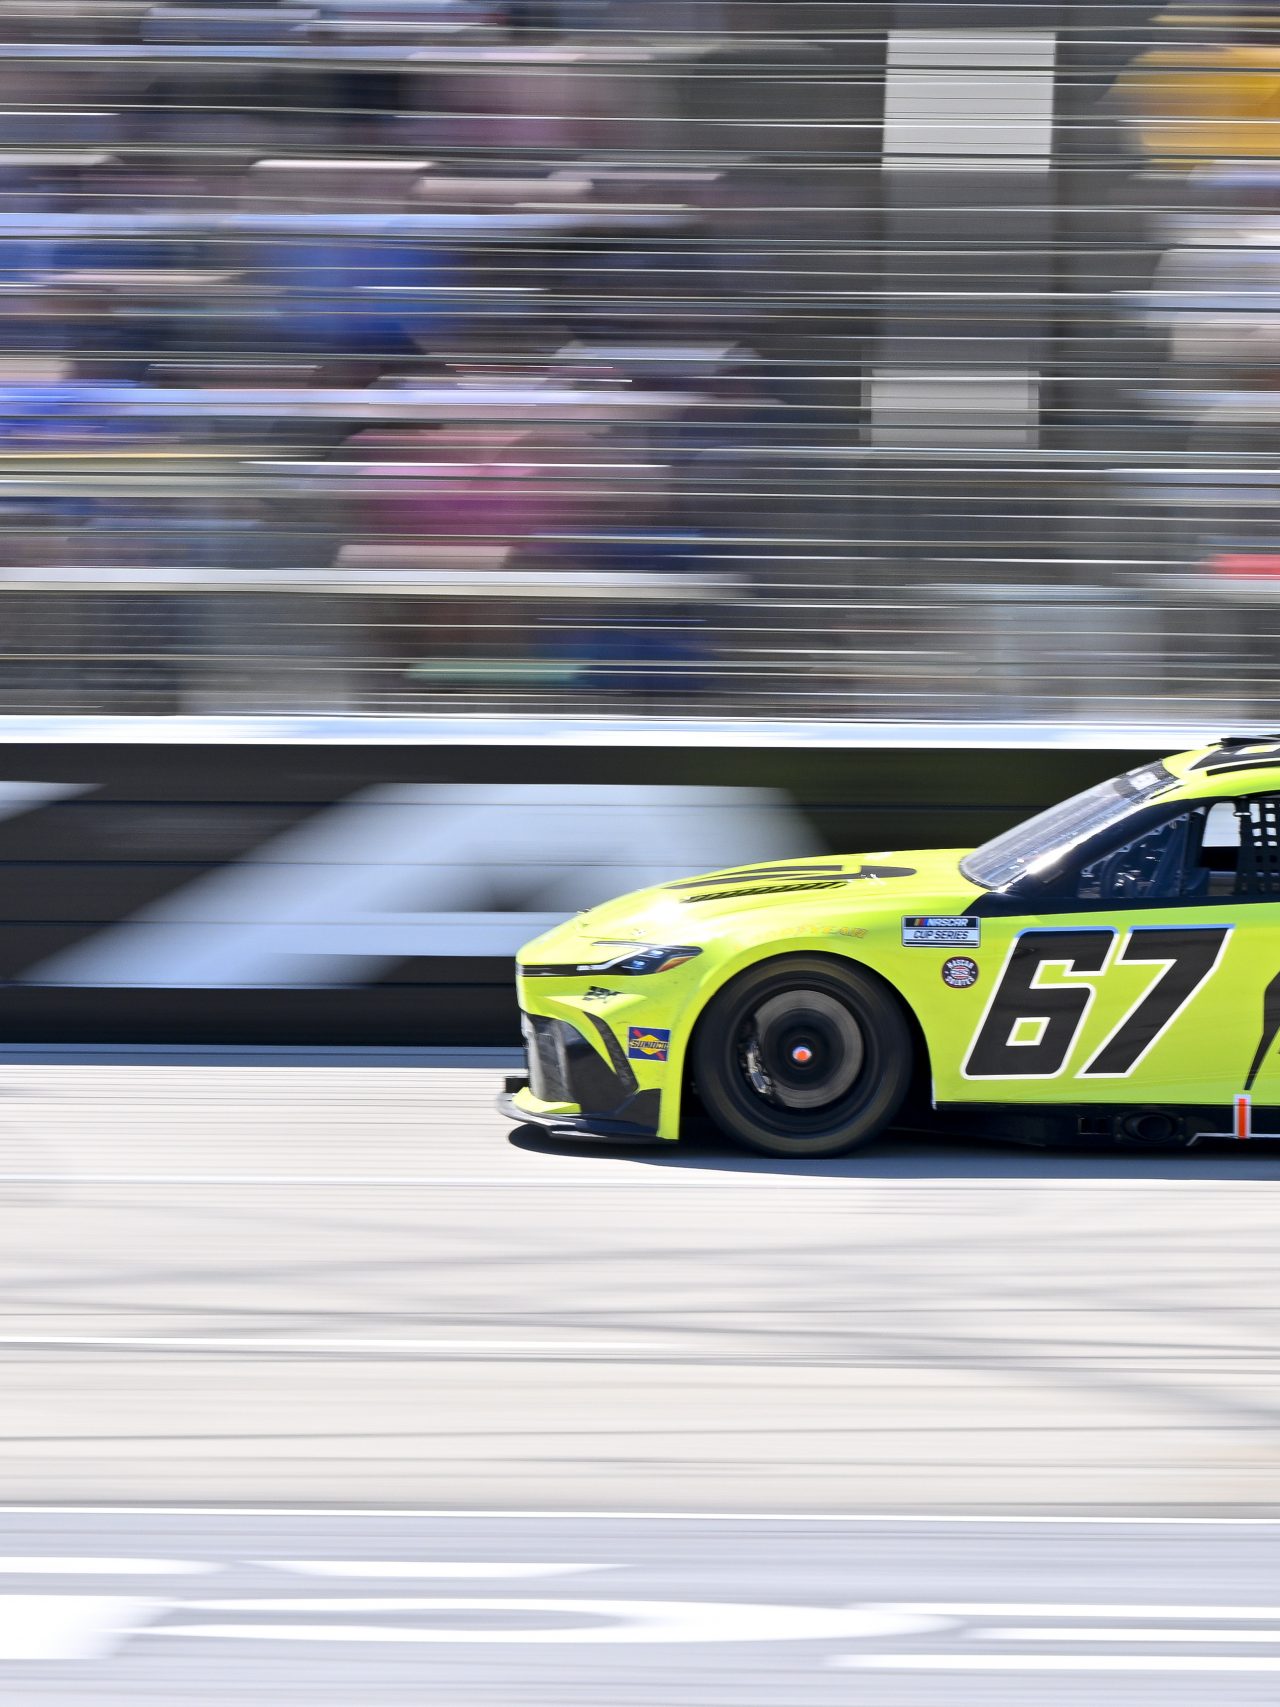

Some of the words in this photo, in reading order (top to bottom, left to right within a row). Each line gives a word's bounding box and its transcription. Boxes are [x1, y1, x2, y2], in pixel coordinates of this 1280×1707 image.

[927, 918, 969, 927] NASCAR
[913, 930, 933, 939] CUP
[934, 930, 969, 940] SERIES
[962, 925, 1235, 1079] 67
[629, 1039, 670, 1051] SUNOCO
